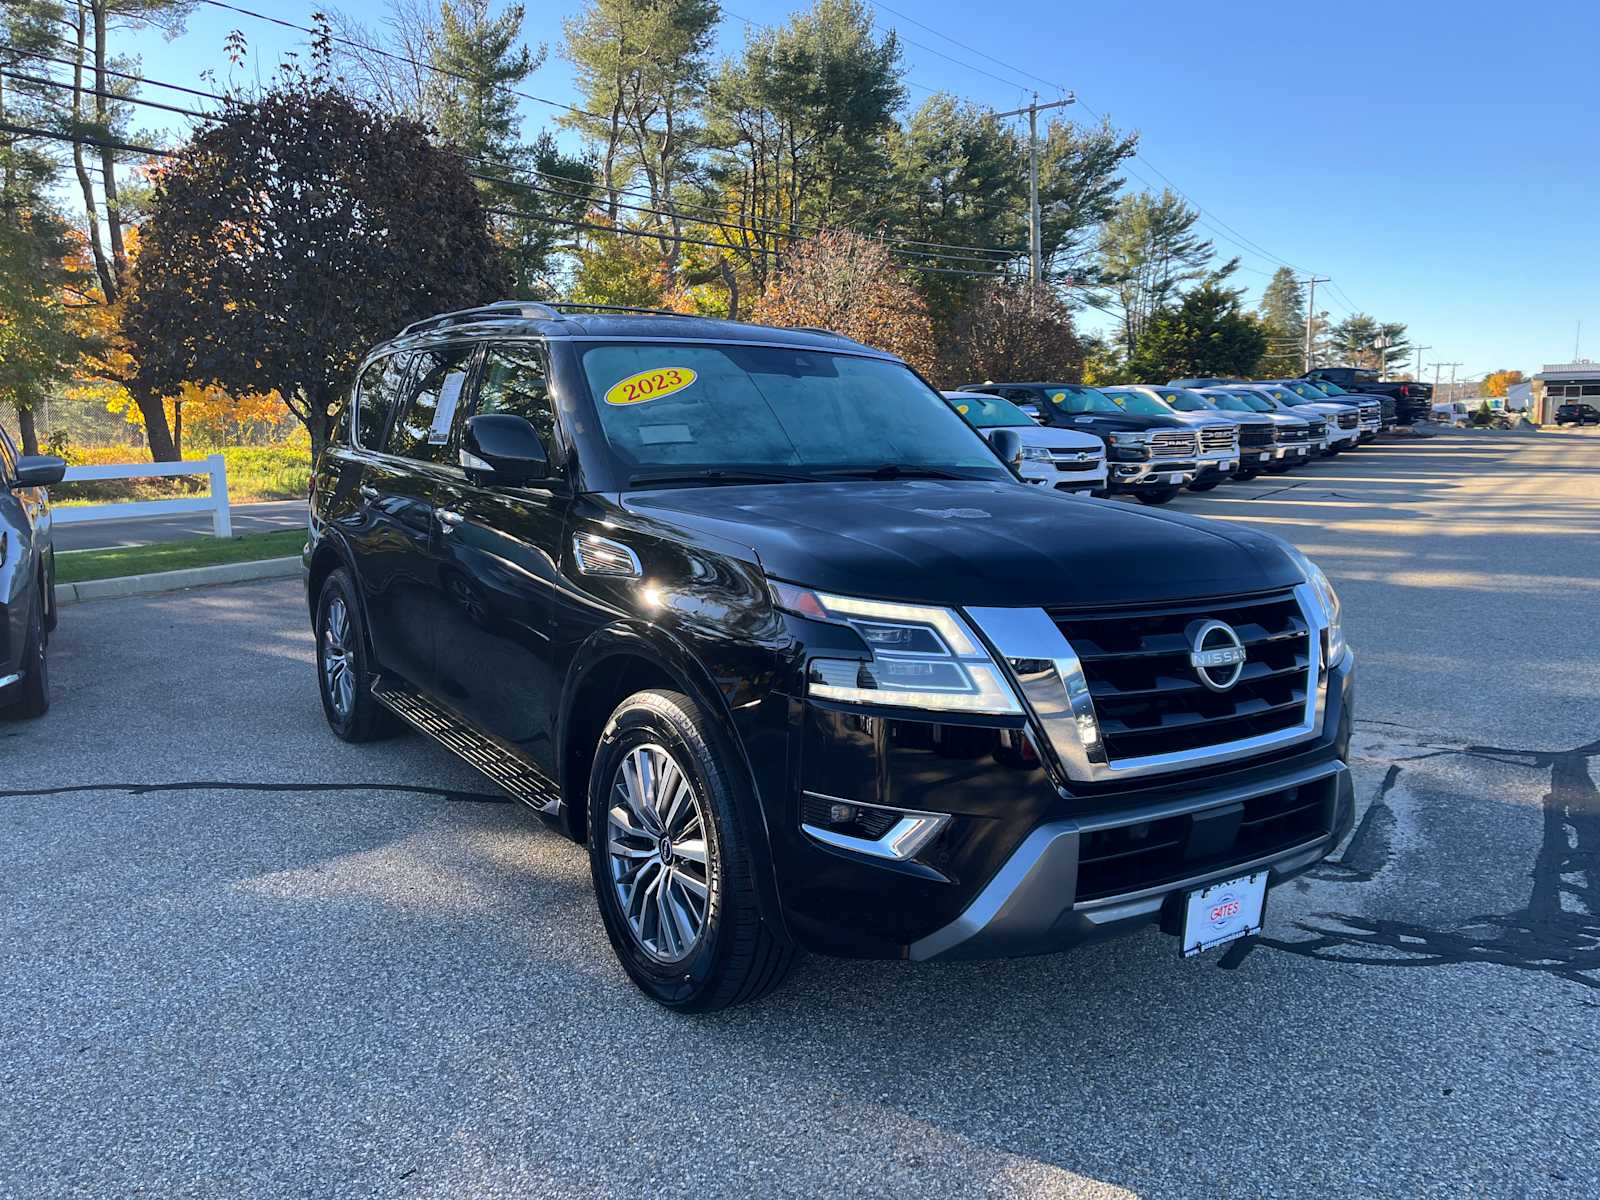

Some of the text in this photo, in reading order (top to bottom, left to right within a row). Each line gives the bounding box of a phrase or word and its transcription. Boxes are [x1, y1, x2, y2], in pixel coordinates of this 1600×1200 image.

[623, 369, 683, 401] 2023
[1194, 649, 1246, 665] NISSAN
[1210, 901, 1239, 921] GATES
